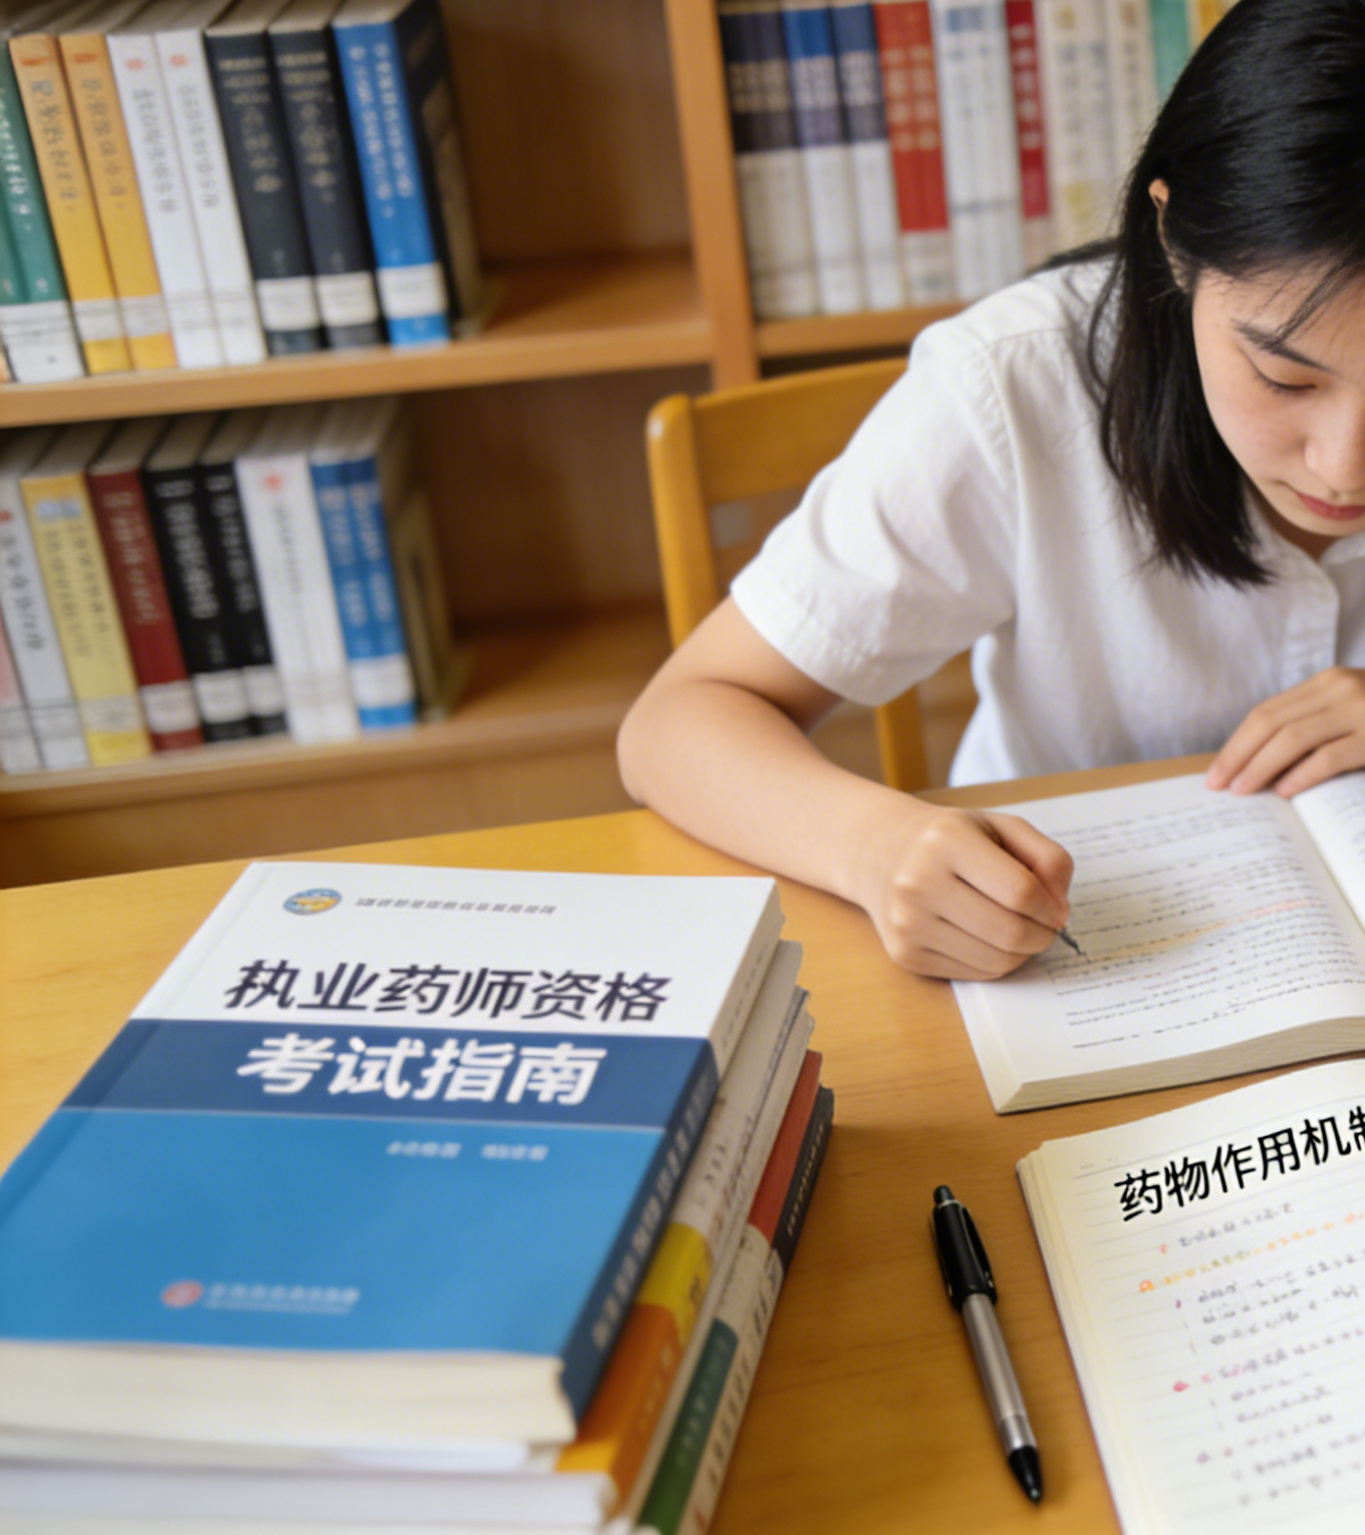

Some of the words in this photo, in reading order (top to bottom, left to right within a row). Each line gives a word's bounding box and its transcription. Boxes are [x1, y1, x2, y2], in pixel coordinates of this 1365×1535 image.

[223, 959, 672, 1022] 执业药师资格
[236, 1033, 607, 1105] 考试指南
